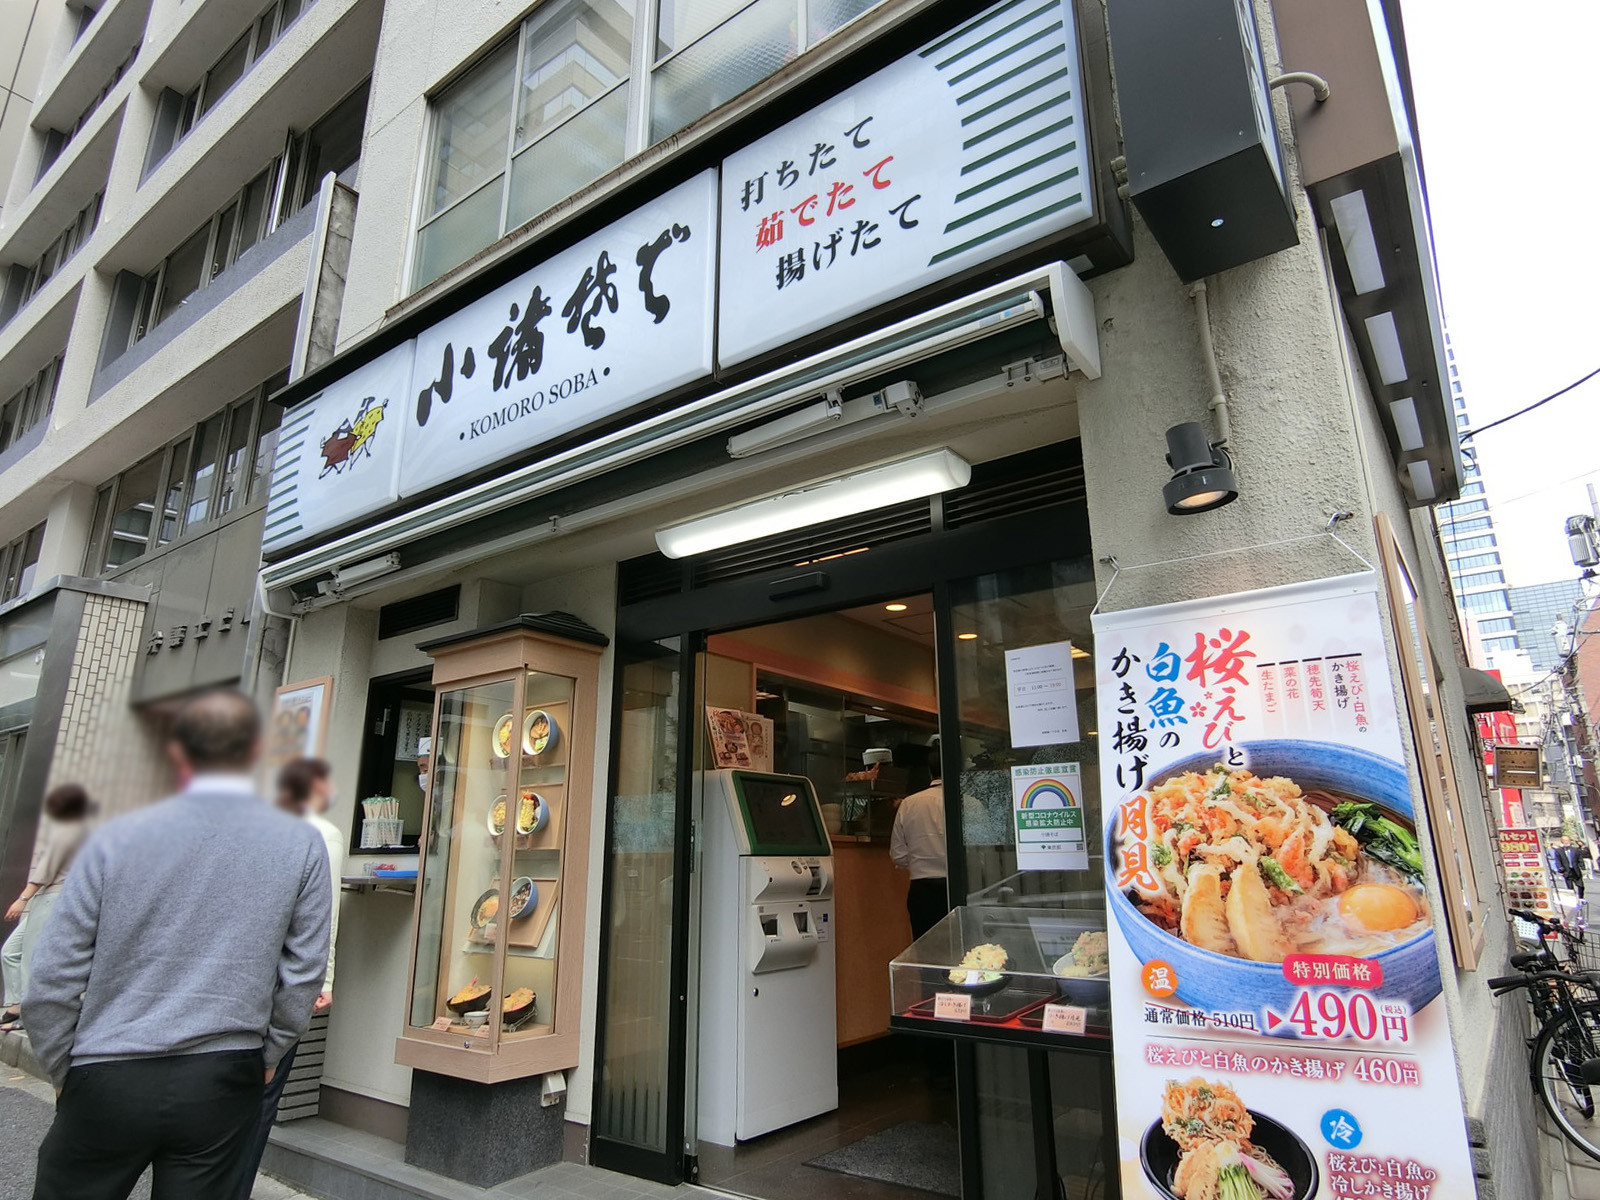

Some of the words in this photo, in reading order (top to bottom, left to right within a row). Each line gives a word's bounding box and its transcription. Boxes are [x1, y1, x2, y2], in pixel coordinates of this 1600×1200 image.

[741, 116, 874, 212] 打ちたて
[755, 155, 894, 254] 茹でたて
[776, 194, 922, 290] 揚げたて
[469, 391, 544, 440] KOMORO
[548, 368, 599, 406] SOBA
[1145, 642, 1189, 749] 白魚の
[1185, 627, 1257, 767] 桜えびと
[1261, 669, 1277, 713] 生たまご
[1283, 666, 1300, 699] 菜の花
[1332, 662, 1351, 709] かき揚げ
[1015, 764, 1077, 776] 感染防止徹底宣言
[1021, 810, 1077, 820] 新型コロナウイルス
[1025, 818, 1074, 827] 感染拡大防止中
[1149, 967, 1173, 992] 温
[1292, 959, 1373, 983] 特別価格
[1143, 1006, 1207, 1028] 通常価格
[1212, 1012, 1255, 1031] 510円
[1145, 1046, 1346, 1081] 桜えびと白魚のかき揚げ
[1353, 1056, 1419, 1086] 460円
[1328, 1115, 1356, 1143] 冷
[1328, 1152, 1437, 1181] 桜えびと白魚の
[1331, 1174, 1431, 1200] 冷しかき揚げ
